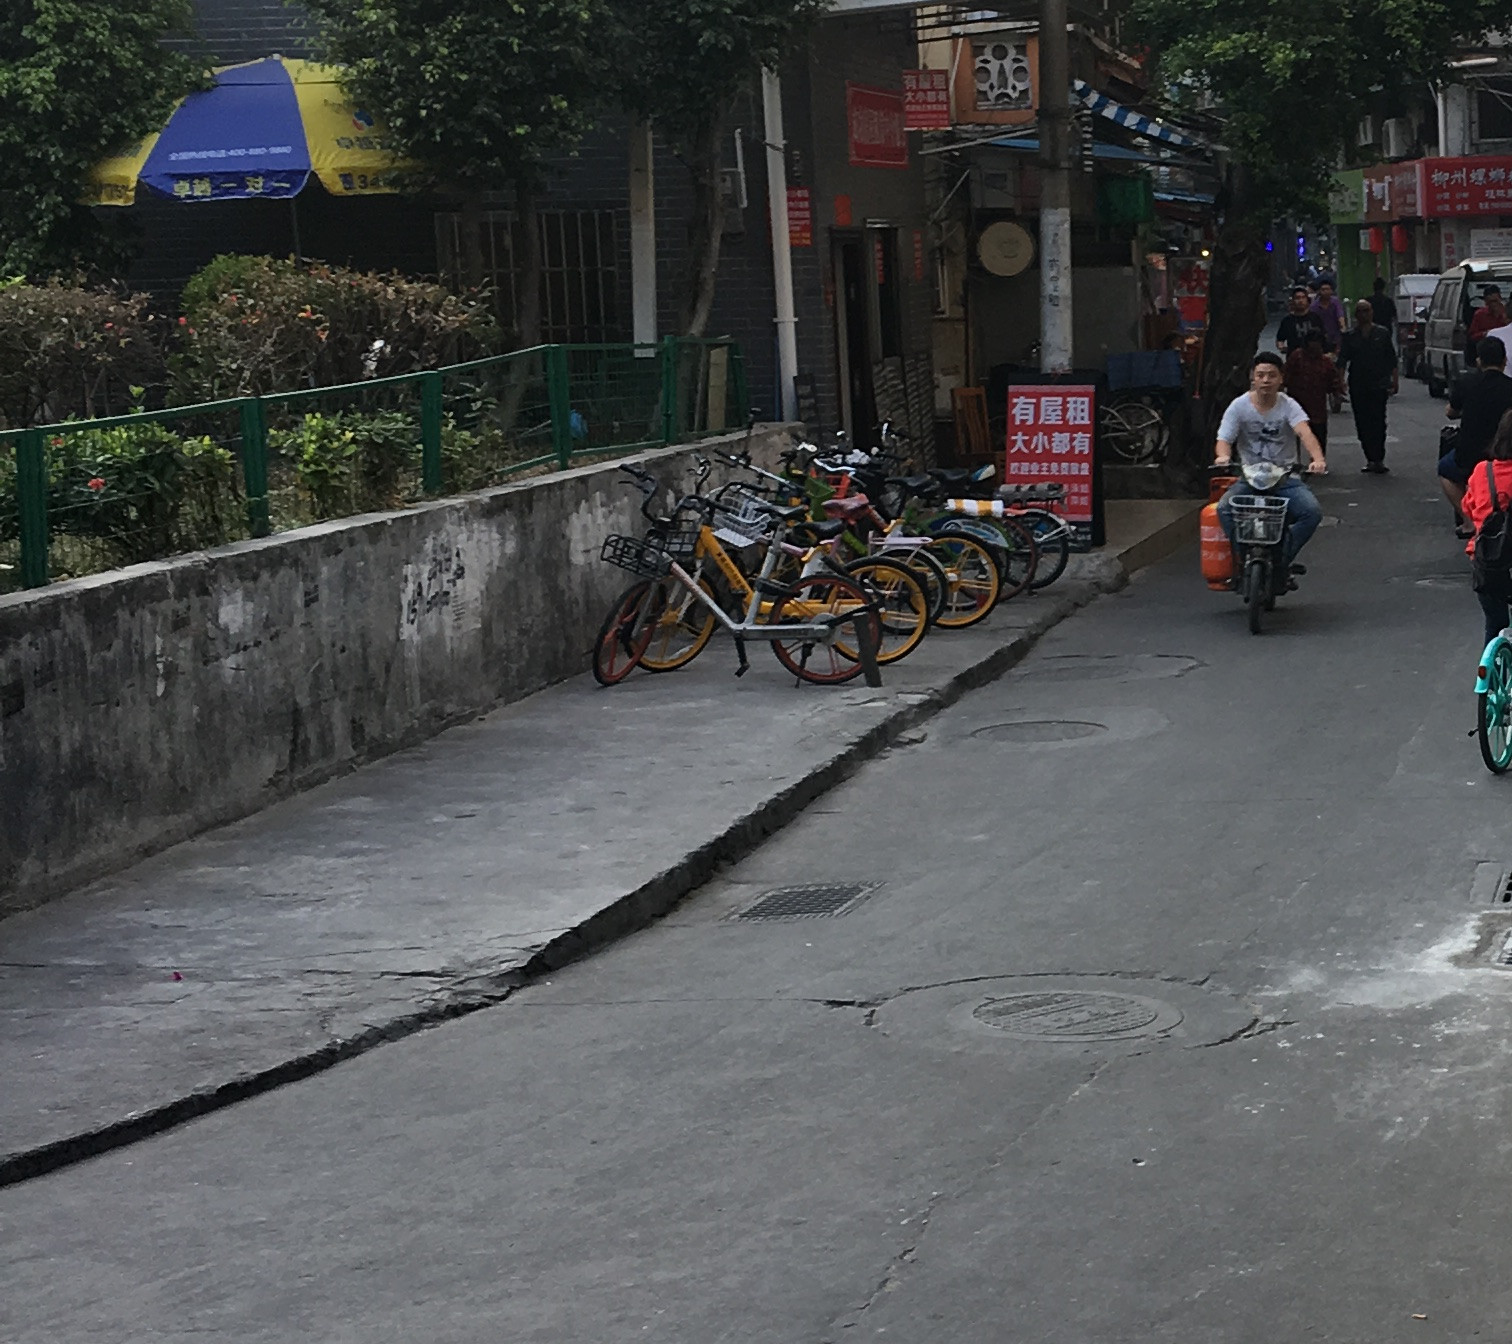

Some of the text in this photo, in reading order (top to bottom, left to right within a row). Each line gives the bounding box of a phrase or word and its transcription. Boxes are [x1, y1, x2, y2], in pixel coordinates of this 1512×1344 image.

[1011, 396, 1091, 426] 有屋租
[1010, 432, 1091, 455] 大小都有
